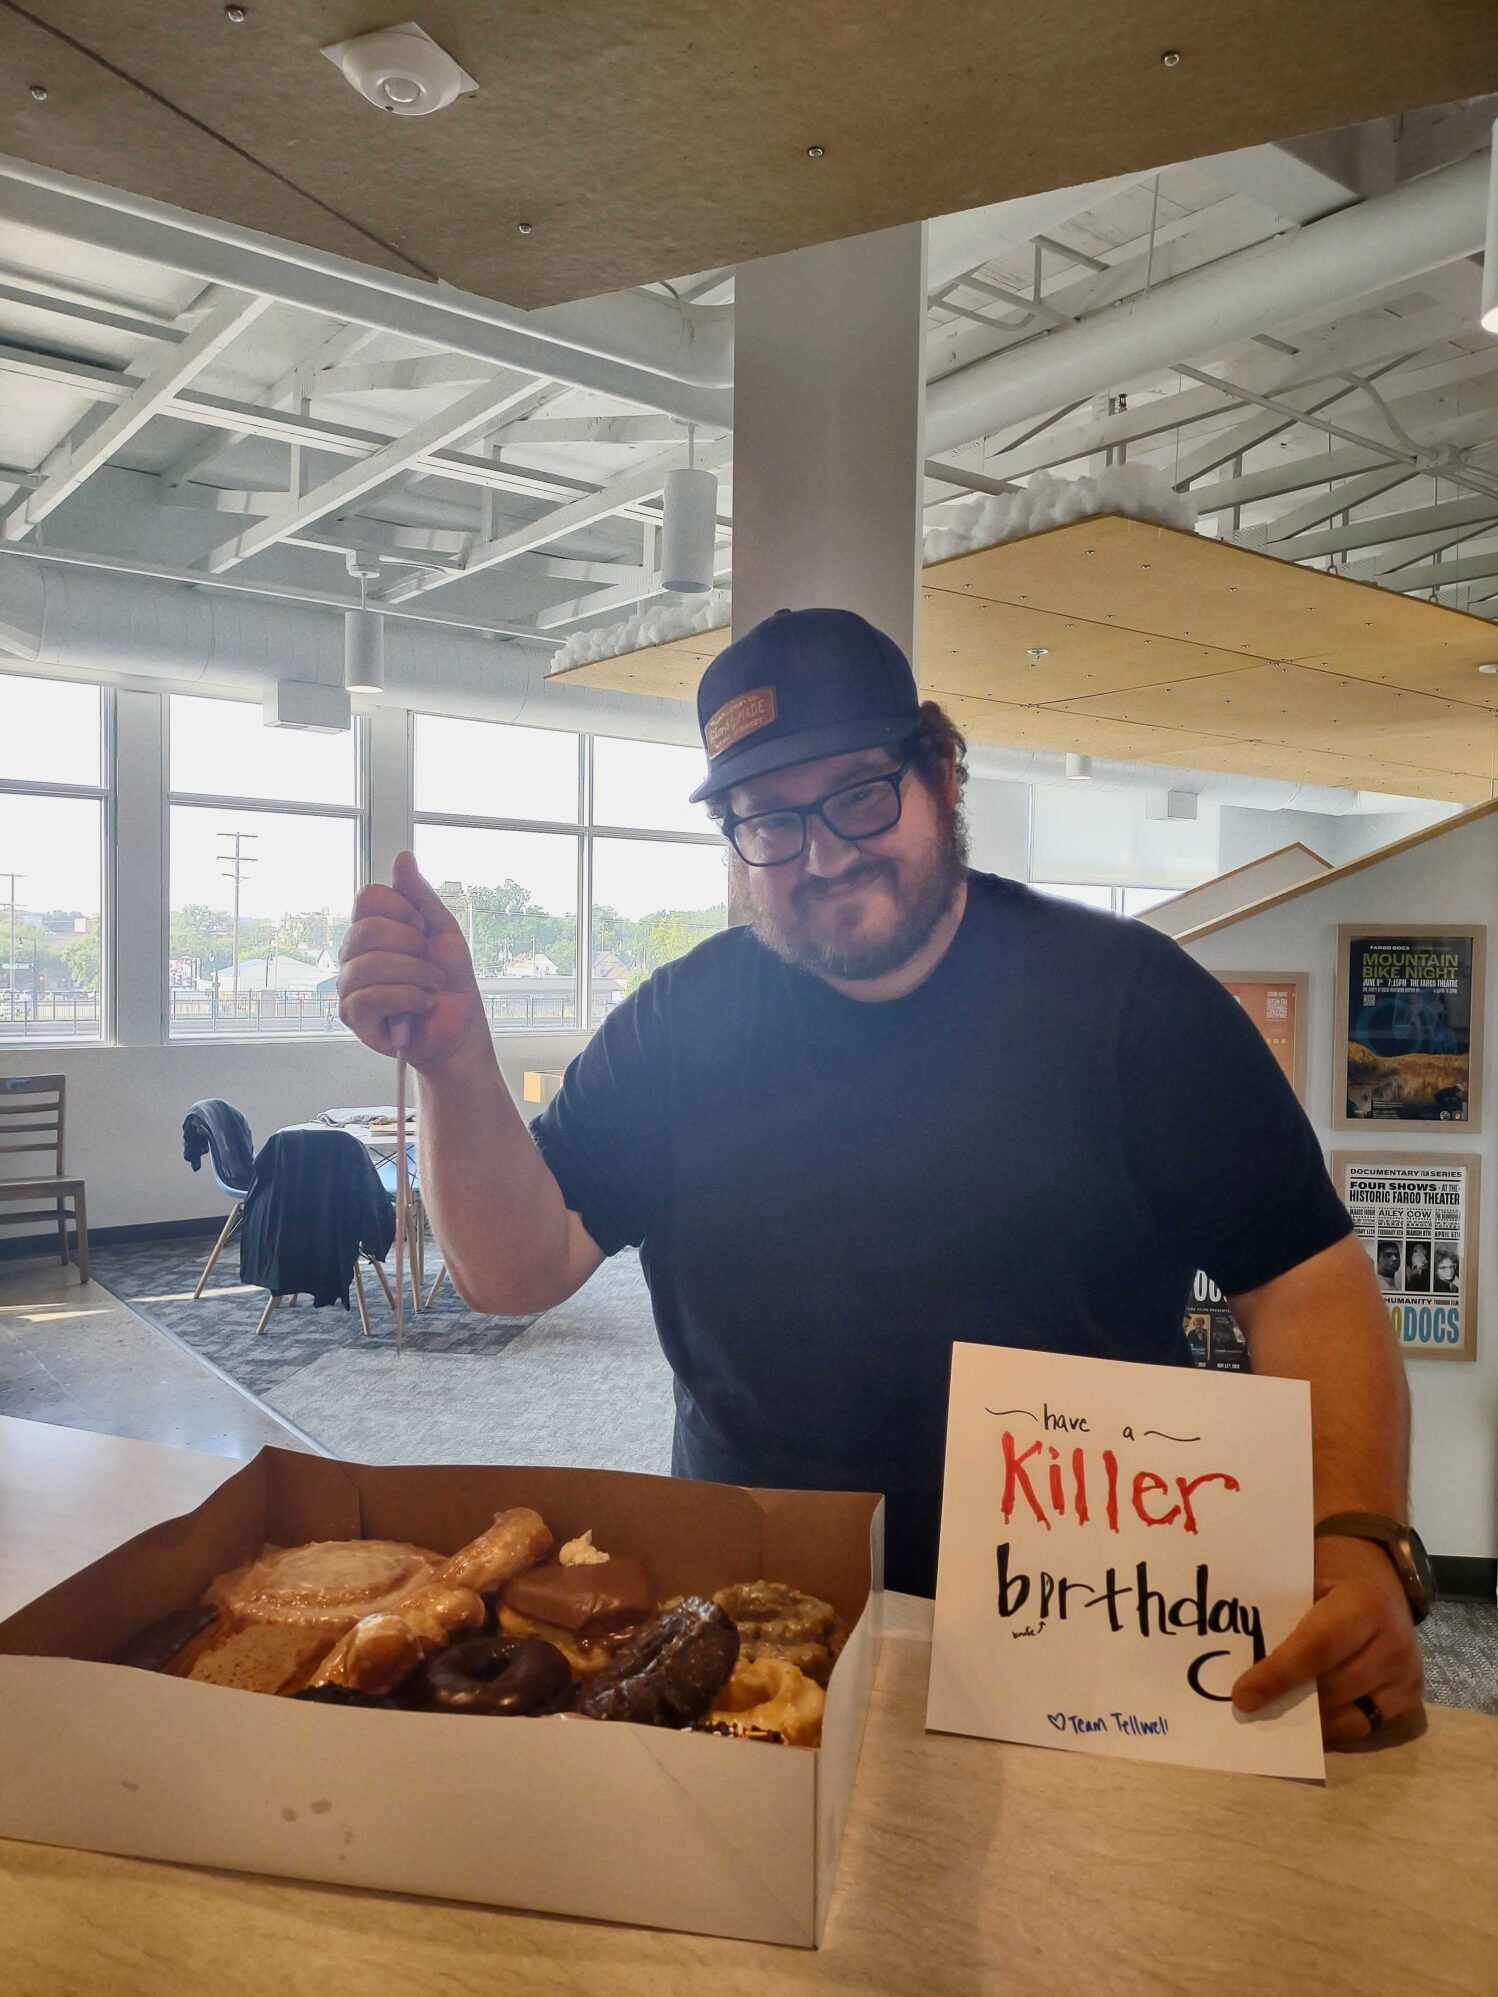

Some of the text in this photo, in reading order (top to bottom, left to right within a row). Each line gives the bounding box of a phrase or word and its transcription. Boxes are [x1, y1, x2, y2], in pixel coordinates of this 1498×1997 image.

[1362, 953, 1459, 967] MOUNTAIN
[1362, 966, 1458, 979] BIKE NIGHT
[1350, 1168, 1419, 1177] DOCUMENTARY
[1350, 1182, 1386, 1190] FOUR
[1388, 1183, 1437, 1191] SHOWS
[1349, 1190, 1460, 1205] HISTORIC FARGO THEATER
[1378, 1209, 1404, 1217] AILEY
[1406, 1210, 1432, 1218] COW
[1384, 1297, 1433, 1305] HUMANITY
[1043, 1402, 1135, 1441] have a
[1000, 1430, 1241, 1536] Killer
[1011, 1625, 1036, 1640] knife
[1067, 1712, 1170, 1736] Team Tellwell
